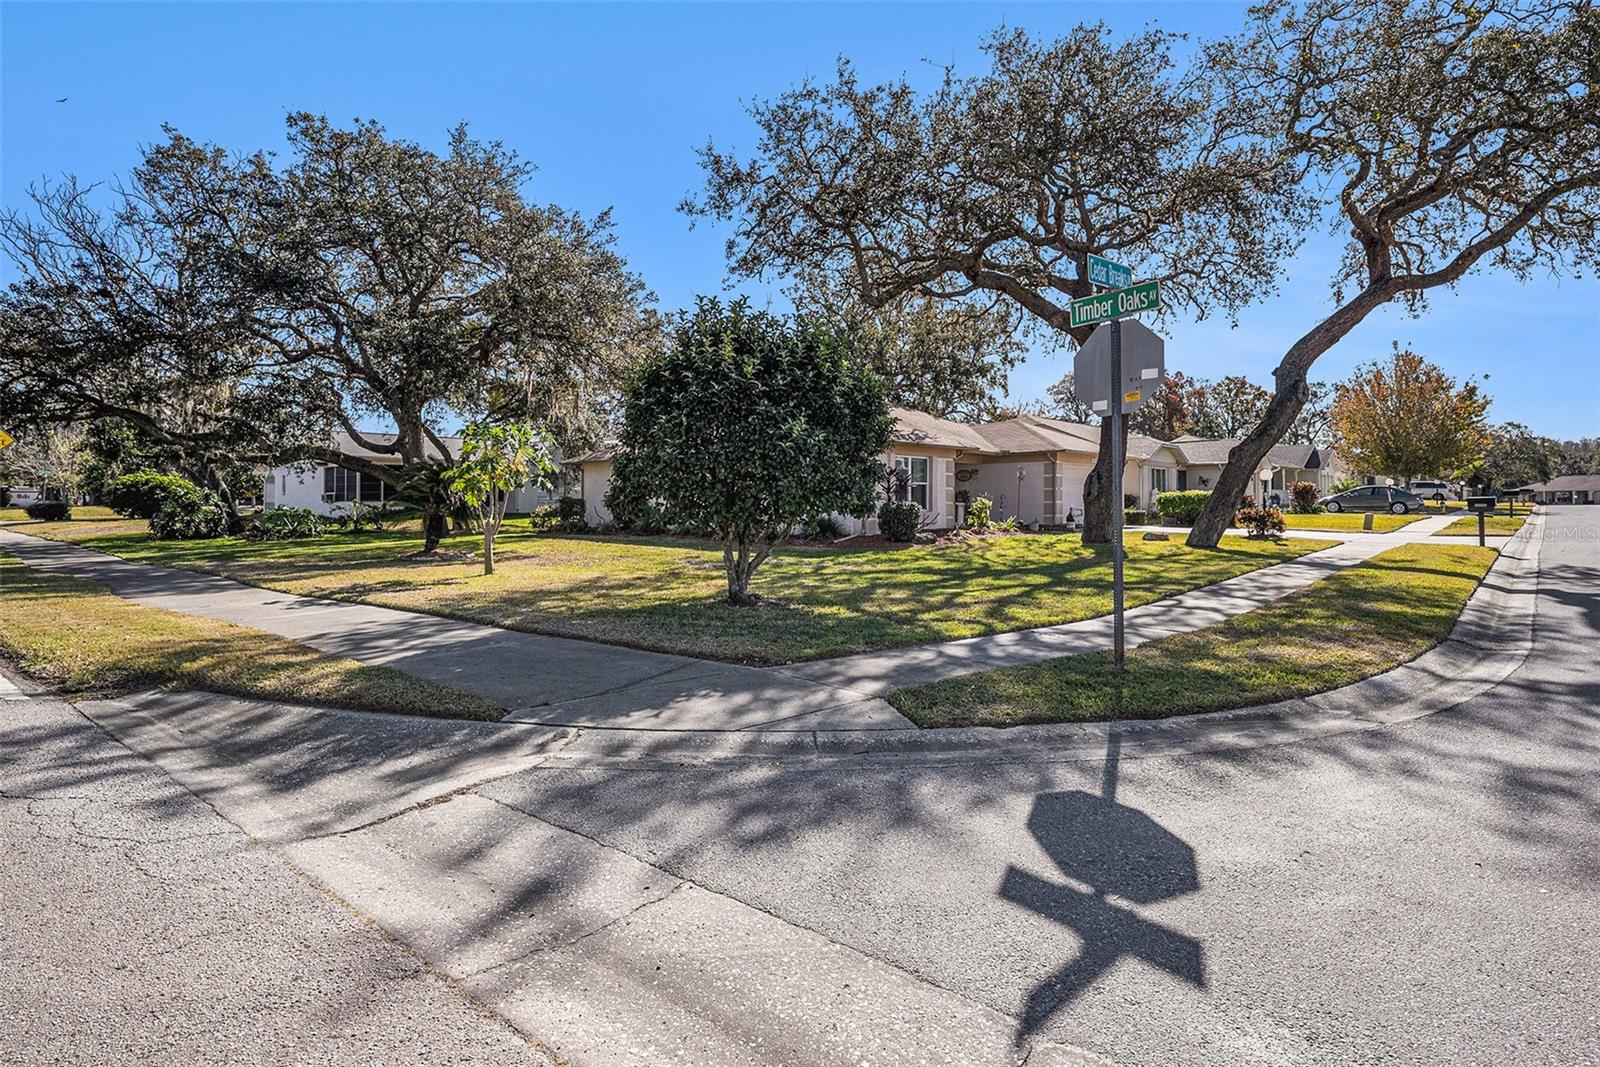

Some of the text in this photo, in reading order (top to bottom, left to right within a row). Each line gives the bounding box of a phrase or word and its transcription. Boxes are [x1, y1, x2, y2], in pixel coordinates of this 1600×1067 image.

[1090, 259, 1107, 281] Cedar
[1108, 264, 1127, 288] Breaks
[1073, 300, 1113, 322] Timber
[1118, 290, 1148, 312] Oaks
